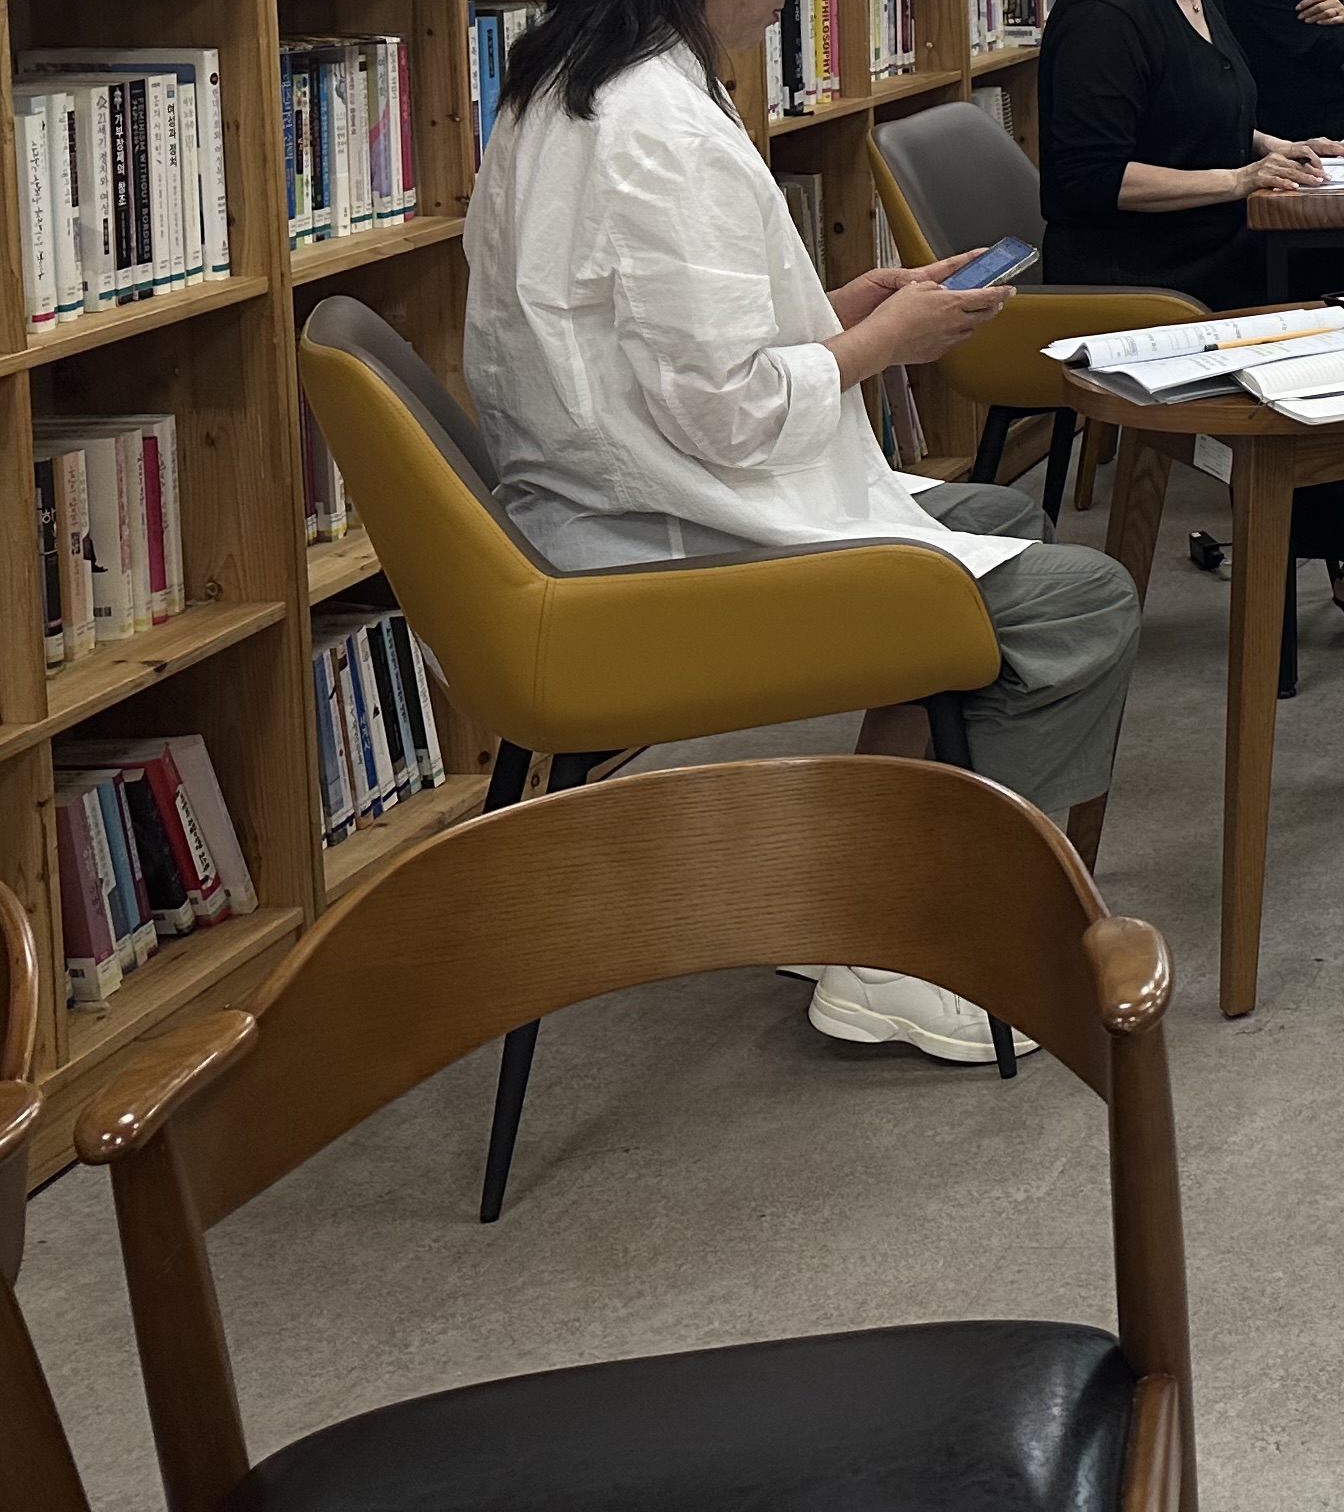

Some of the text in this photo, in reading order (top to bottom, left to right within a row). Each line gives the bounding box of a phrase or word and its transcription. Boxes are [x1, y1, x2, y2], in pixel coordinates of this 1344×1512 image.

[114, 113, 127, 207] 가부장제의 창조
[138, 96, 151, 260] FEMINISM WITHOUT BORDERS
[167, 103, 178, 167] 여성과 정치
